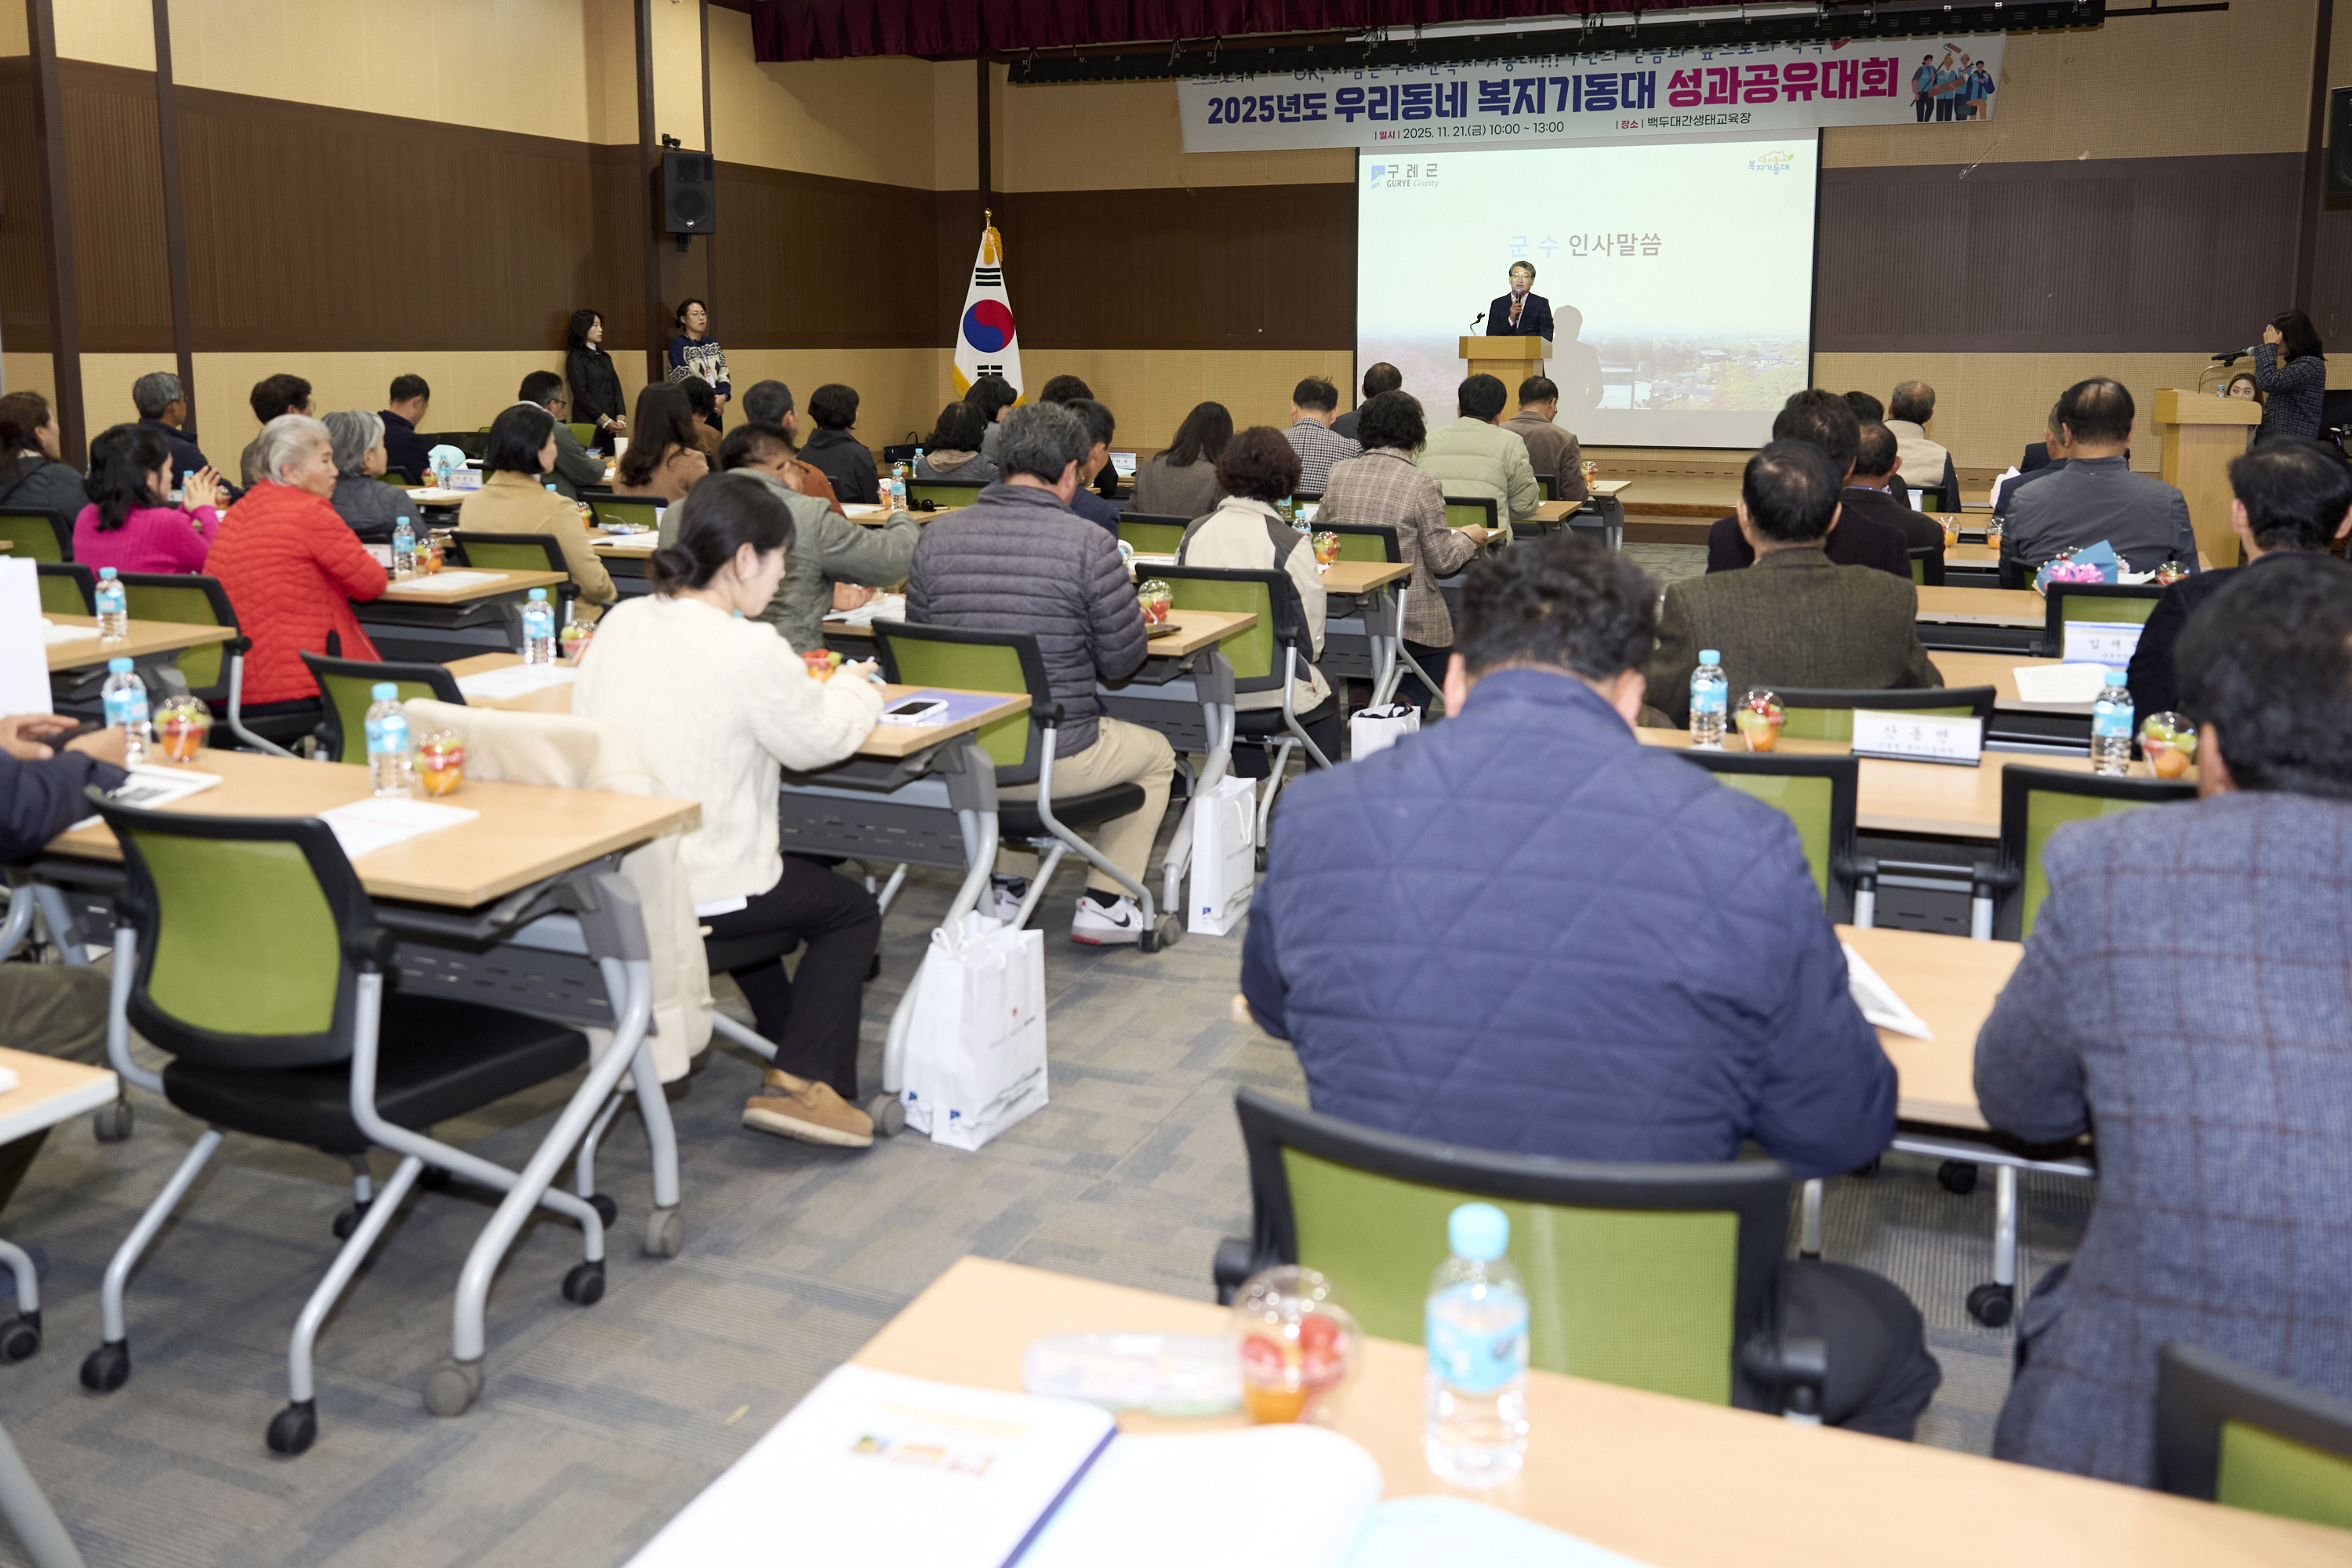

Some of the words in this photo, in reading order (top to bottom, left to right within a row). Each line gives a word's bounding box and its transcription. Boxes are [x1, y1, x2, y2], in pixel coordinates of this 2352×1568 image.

[1207, 92, 1327, 124] 2025년도
[1334, 81, 1468, 123] 우리동네
[1478, 71, 1656, 115] 복지기동대
[1667, 57, 1899, 107] 성과공유대회
[1647, 112, 1752, 128] 백두대간생태교육장
[1403, 128, 1434, 140] 2025.
[1437, 126, 1450, 137] 11.
[1453, 125, 1486, 137] 21.(금)
[1489, 123, 1520, 135] 10:00
[1534, 121, 1565, 133] 13:00
[1748, 160, 1790, 176] 복지기동대
[1386, 179, 1411, 187] GURYE
[1414, 179, 1439, 188] County
[1569, 233, 1662, 257] 인사말씀
